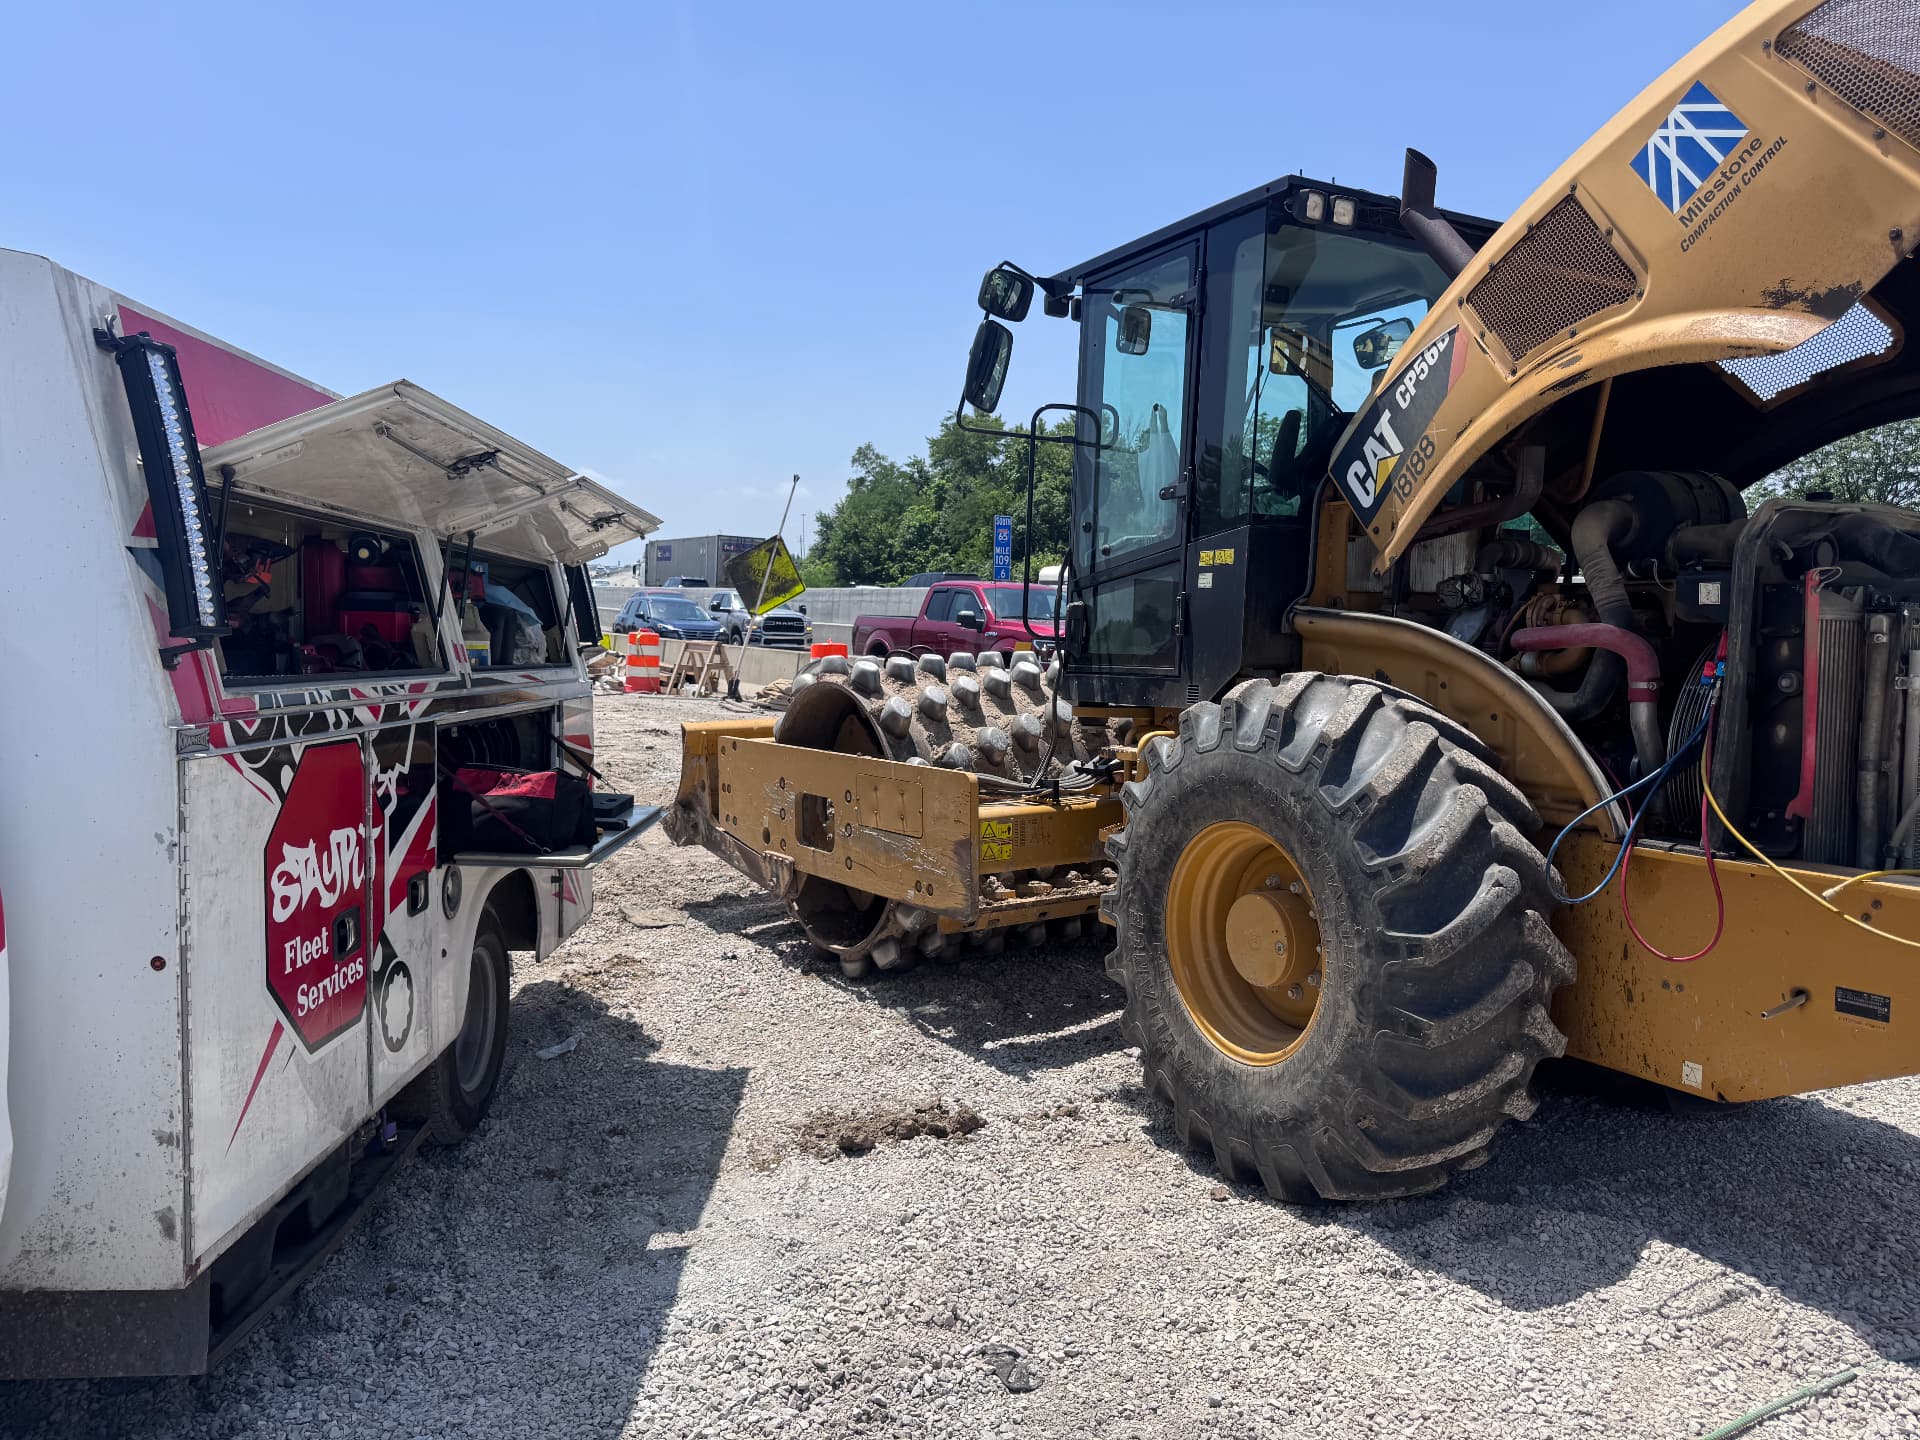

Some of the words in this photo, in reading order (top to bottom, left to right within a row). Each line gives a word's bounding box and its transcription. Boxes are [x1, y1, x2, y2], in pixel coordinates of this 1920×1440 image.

[1678, 137, 1763, 228] Milestone
[1680, 184, 1742, 253] COMPACTION
[1741, 136, 1788, 187] CONTROL
[1346, 408, 1404, 509] CAT
[1392, 434, 1436, 505] 18188
[995, 516, 1011, 526] SOUTH
[998, 532, 1008, 541] 65
[995, 546, 1010, 555] MILE
[995, 554, 1010, 566] 109
[284, 926, 329, 975] Fleet
[297, 956, 364, 1018] Services
